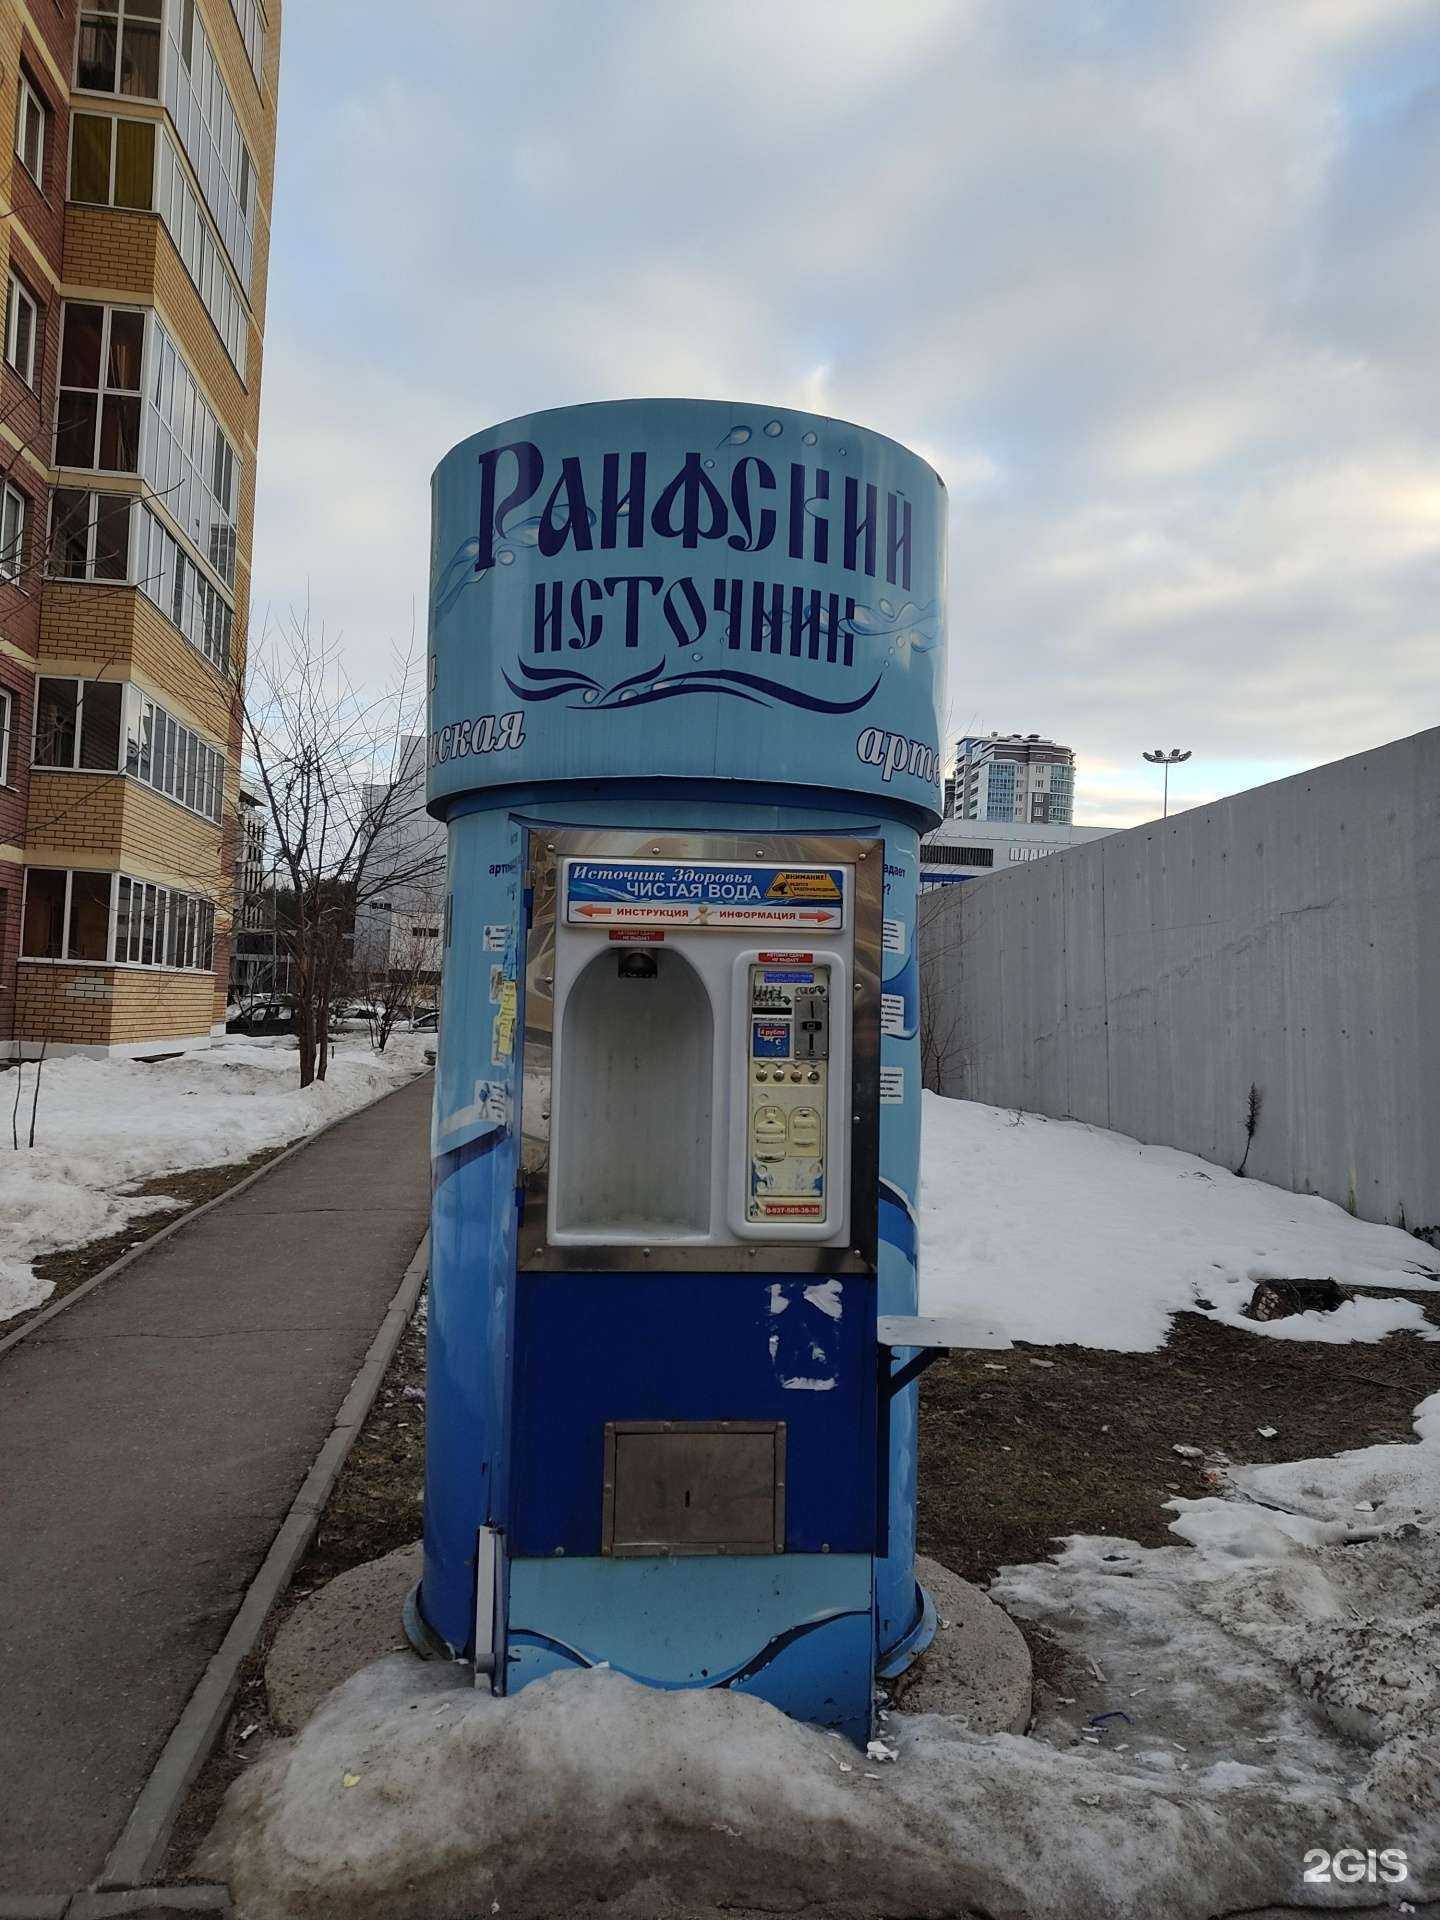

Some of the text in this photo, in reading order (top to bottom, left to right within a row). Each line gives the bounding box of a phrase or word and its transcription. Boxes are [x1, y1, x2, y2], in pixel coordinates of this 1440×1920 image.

[573, 866, 753, 886] Источник Здоровья
[626, 882, 762, 900] ЧИСТАЯ ВОДА
[616, 907, 797, 921] ИНСТРУКЦИЯ ИНФОРМАЦИЯ
